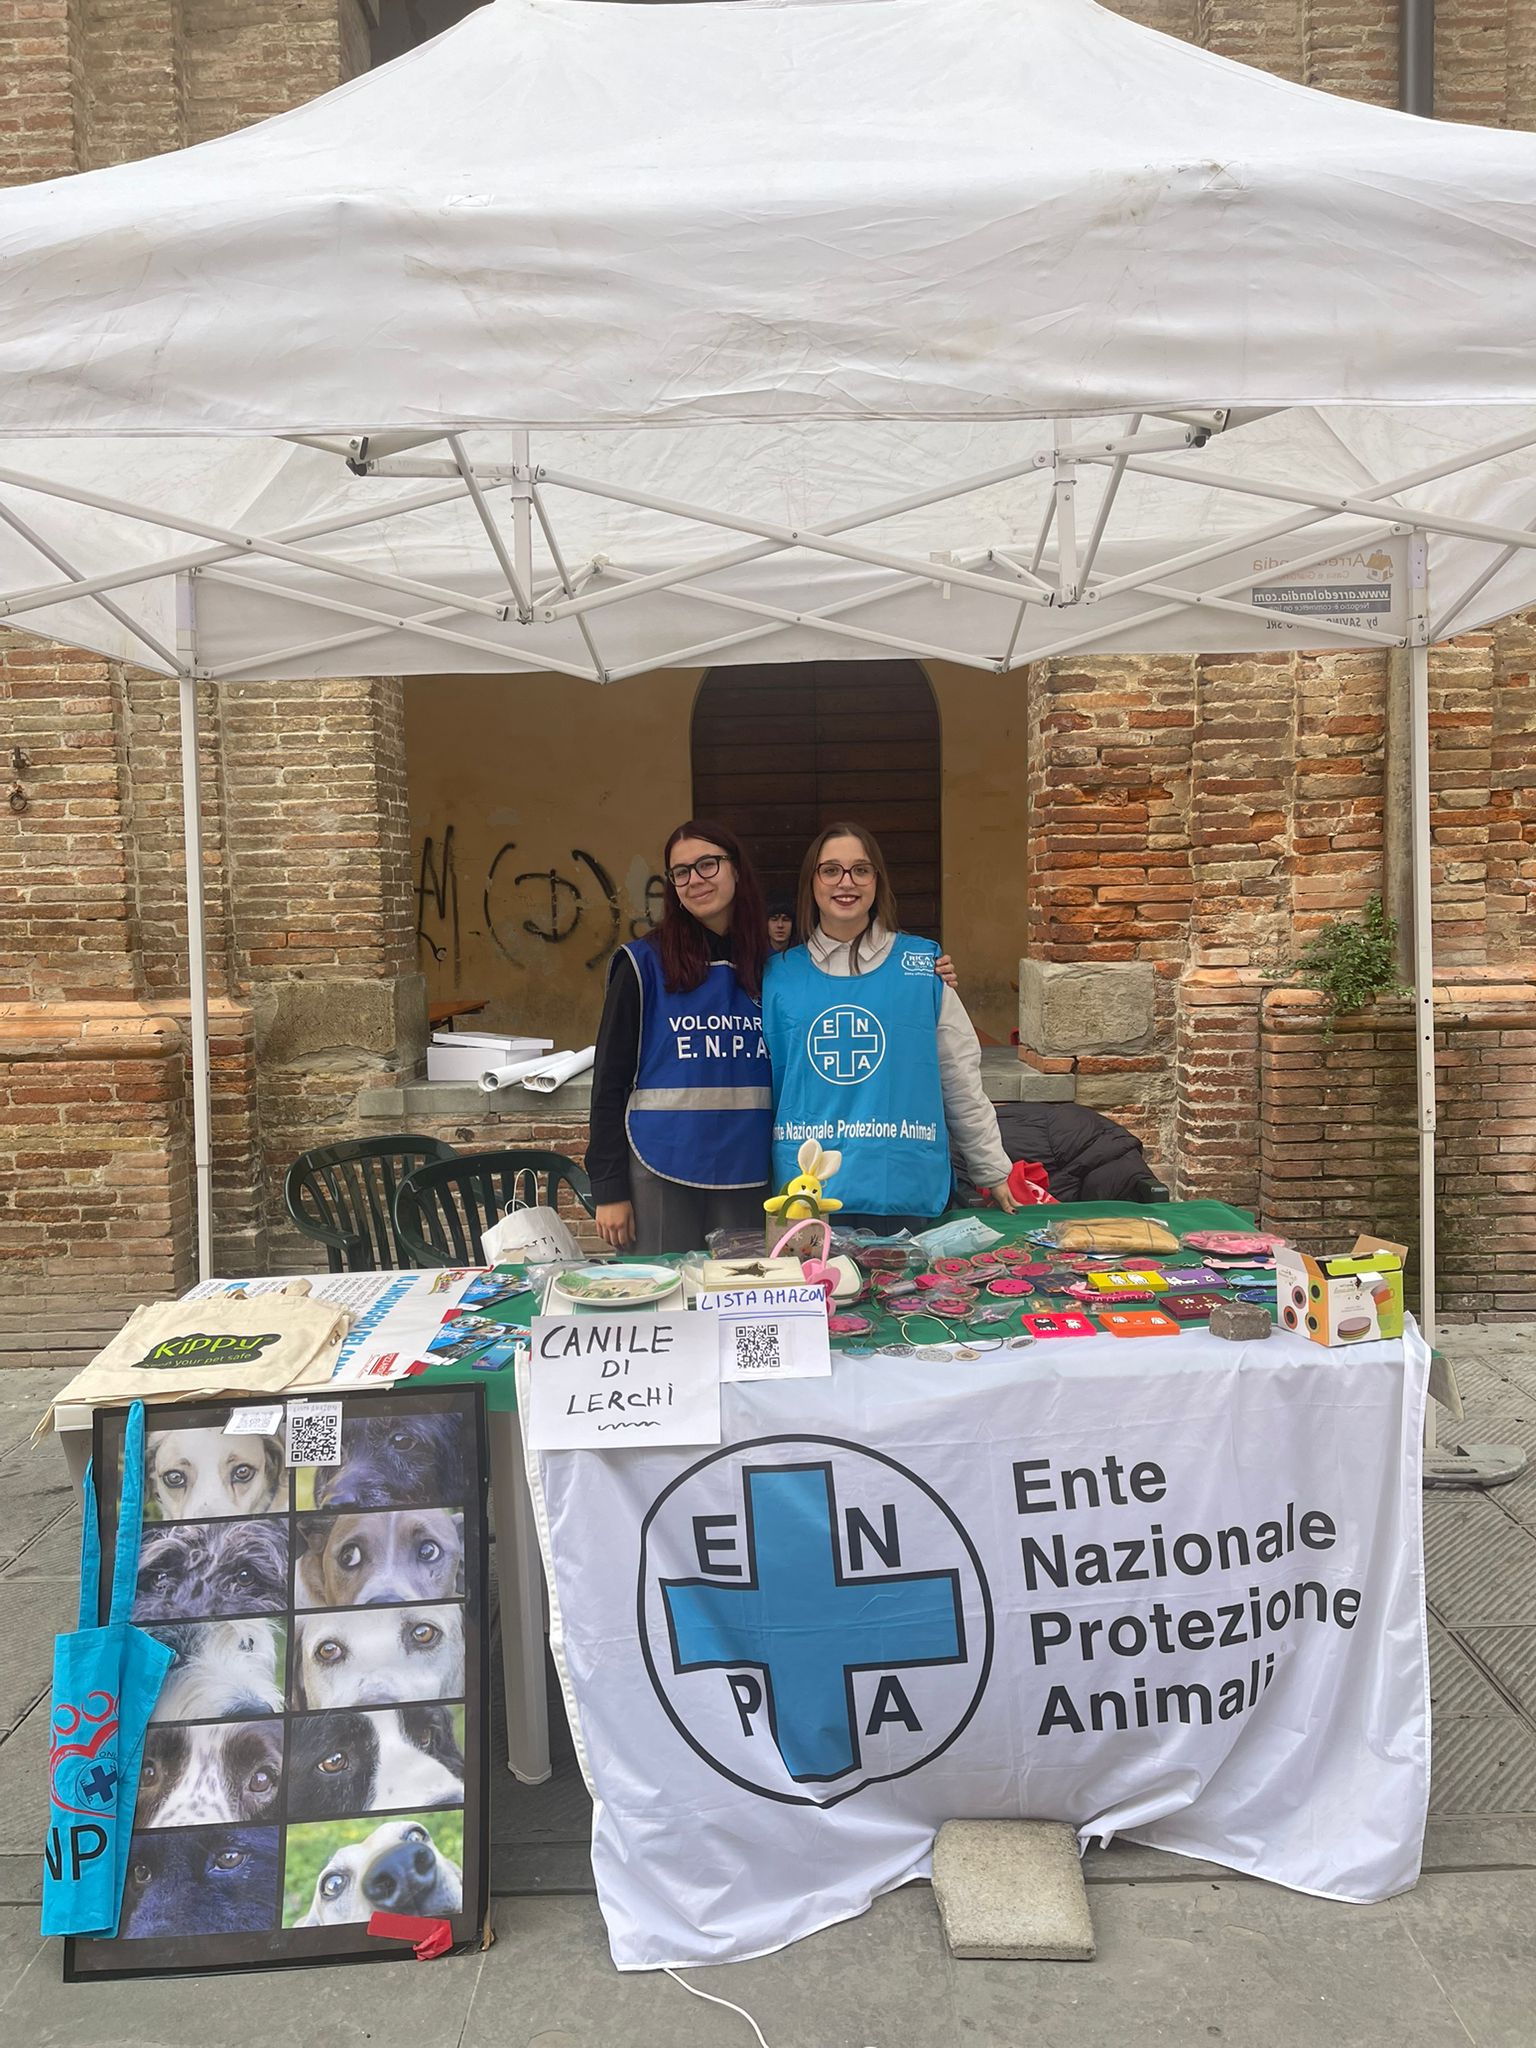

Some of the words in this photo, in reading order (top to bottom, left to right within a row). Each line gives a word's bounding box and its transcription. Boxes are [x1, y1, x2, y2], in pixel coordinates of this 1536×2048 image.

[668, 1014, 763, 1032] VOLONTAR
[823, 1019, 834, 1035] E
[856, 1017, 869, 1033] N
[824, 1056, 835, 1070] P
[857, 1055, 871, 1070] A
[773, 1122, 785, 1141] nte
[786, 1119, 834, 1141] Nazionale
[837, 1118, 898, 1139] Protezione
[900, 1119, 937, 1142] Animali
[353, 1283, 414, 1330] LINGUAGGIO
[700, 1290, 757, 1311] LISTA
[763, 1287, 825, 1304] AMAZON
[153, 1336, 264, 1358] Kippy
[174, 1359, 201, 1368] your
[227, 1352, 252, 1361] safe
[540, 1325, 674, 1360] CANILE
[601, 1358, 630, 1379] DI
[1012, 1455, 1167, 1514] Ente
[693, 1515, 743, 1576] E
[846, 1504, 902, 1571] N
[1020, 1502, 1337, 1591] Nazionale
[1031, 1580, 1362, 1666] Protezione
[726, 1674, 762, 1737] P
[864, 1674, 924, 1736] A
[1037, 1654, 1274, 1736] Animali
[46, 1823, 108, 1881] NP
